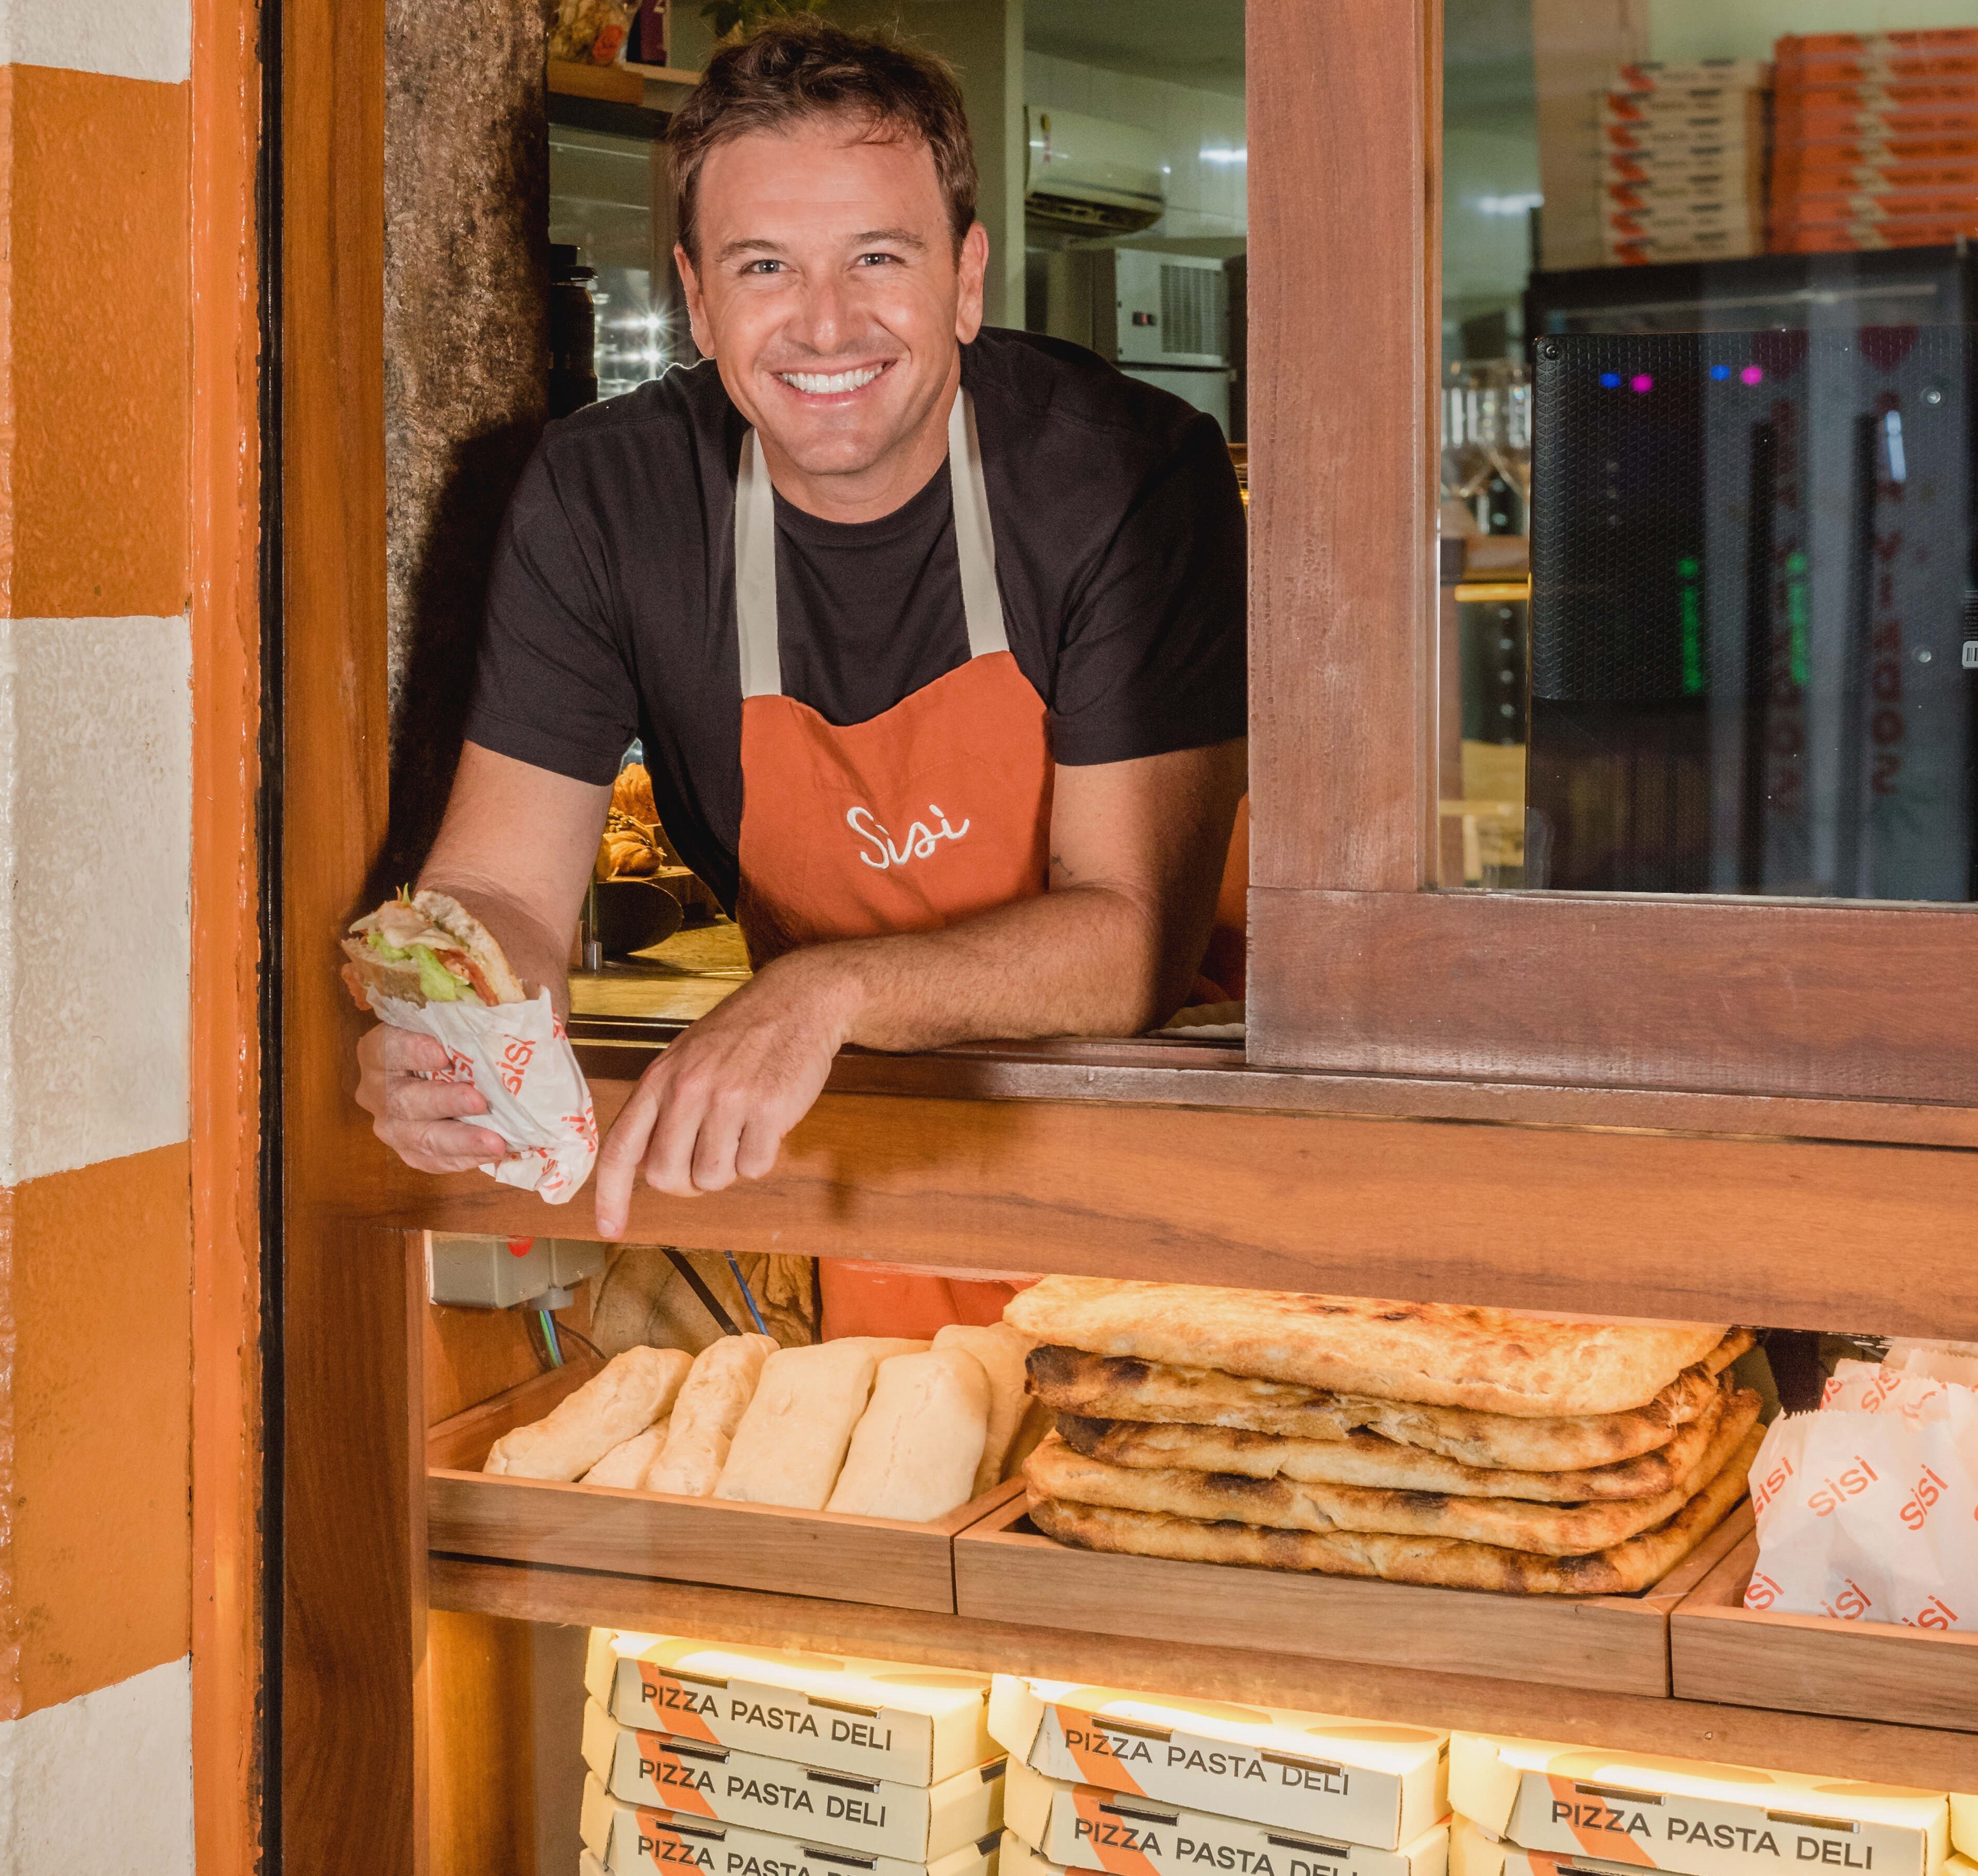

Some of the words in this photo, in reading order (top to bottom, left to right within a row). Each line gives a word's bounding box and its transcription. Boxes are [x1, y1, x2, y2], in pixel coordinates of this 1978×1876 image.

[847, 804, 970, 869] Sisi
[1808, 1455, 1879, 1517] sisi
[1900, 1463, 1948, 1531] sisi
[1818, 1578, 1872, 1620] isi
[641, 1682, 718, 1718] PIZZA
[731, 1700, 818, 1737] PASTA
[831, 1719, 891, 1751] DELI
[639, 1758, 715, 1793] PIZZA
[727, 1776, 814, 1814] PASTA
[826, 1795, 886, 1828] DELI
[1065, 1729, 1152, 1763] PIZZA
[1167, 1745, 1267, 1782] PASTA
[1282, 1766, 1349, 1795] DELI
[638, 1835, 714, 1871] PIZZA
[1074, 1817, 1162, 1856] PIZZA
[1176, 1837, 1275, 1876] PASTA
[1551, 1800, 1651, 1837] PIZZA
[1668, 1817, 1781, 1857] PASTA
[1796, 1836, 1873, 1870] DELI
